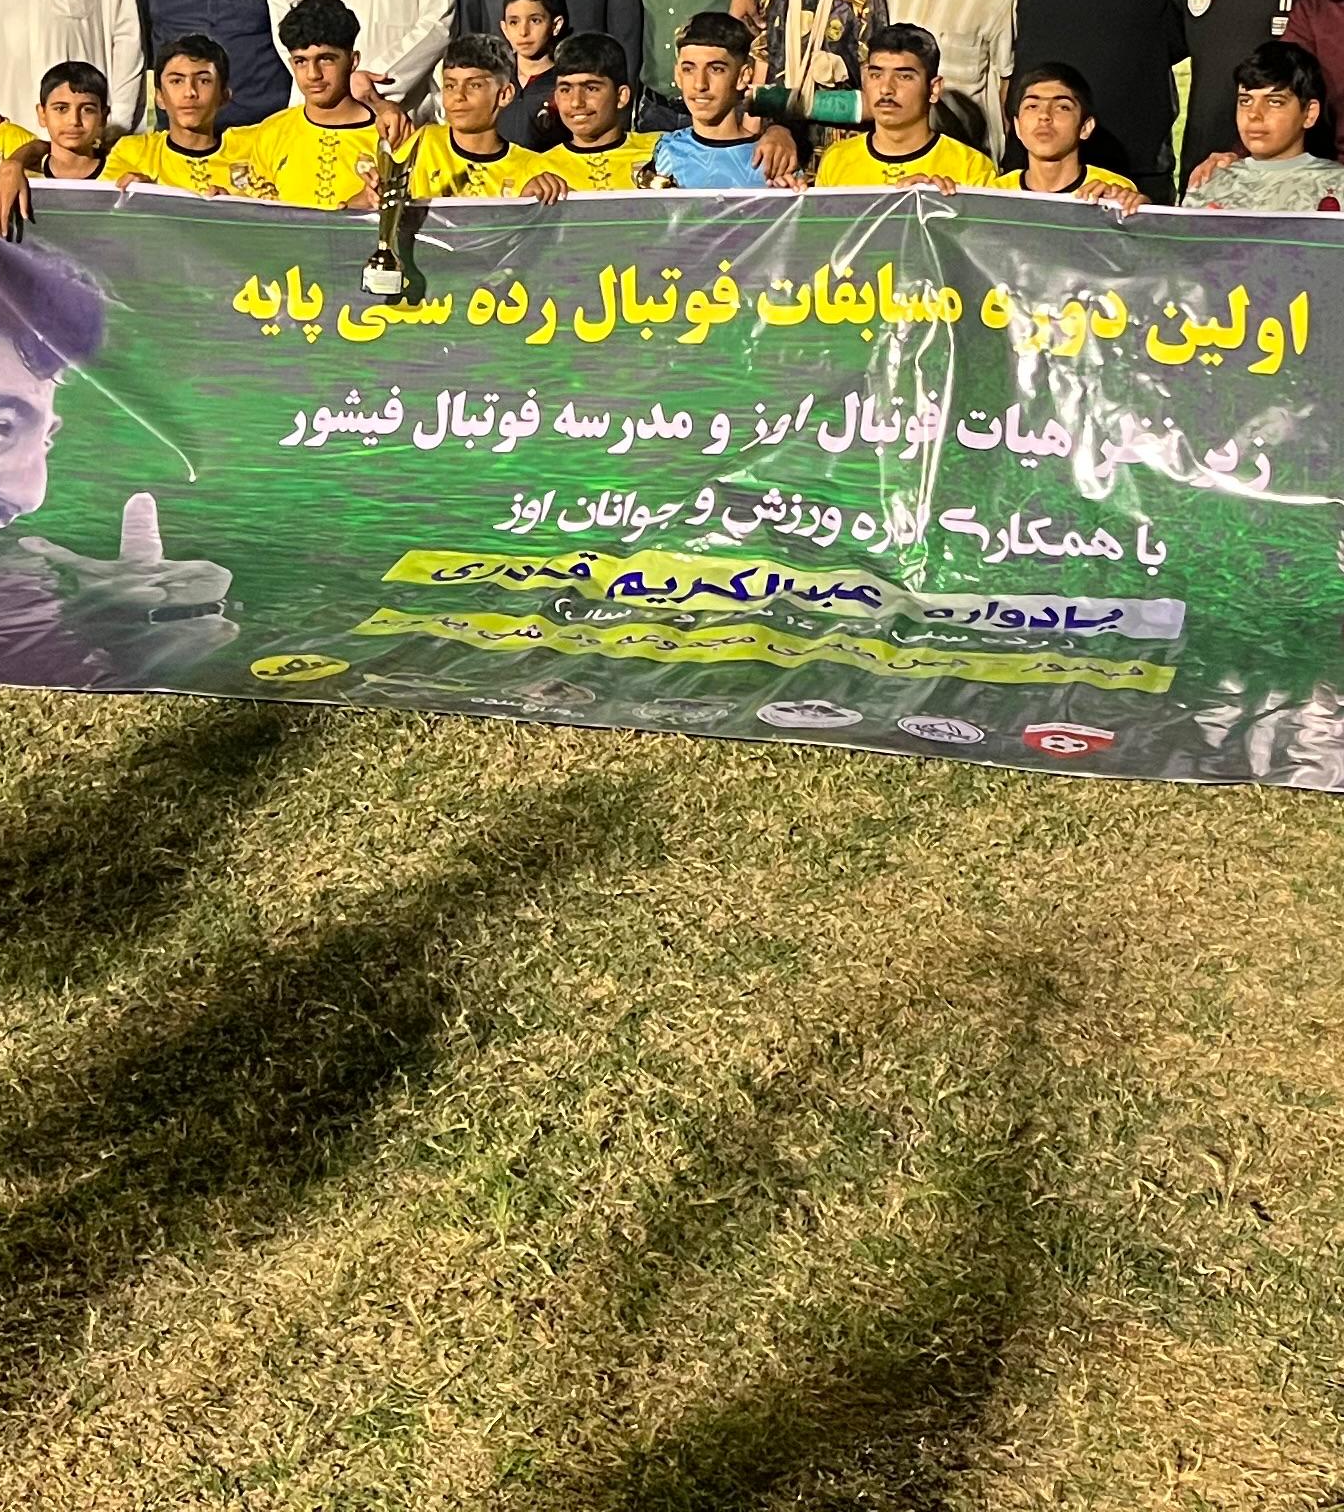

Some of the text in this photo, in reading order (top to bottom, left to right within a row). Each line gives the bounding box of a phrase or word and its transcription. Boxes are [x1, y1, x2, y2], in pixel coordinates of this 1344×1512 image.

[232, 259, 1310, 376] اولین دوره مسابقات فوتبال رده سنی پایه
[278, 384, 405, 447] فیشور
[412, 387, 542, 453] فوتبال
[553, 400, 694, 455] مدرسه
[700, 413, 732, 455] و
[816, 390, 943, 461] فوتبال
[957, 402, 1073, 468] هیات
[492, 488, 557, 535] اوز
[556, 490, 685, 544] جوانان
[684, 486, 716, 526] و
[721, 487, 843, 547] ورزش
[938, 504, 1125, 565] همکاری
[1136, 520, 1168, 576] با
[606, 565, 883, 610] عبدالکریم
[922, 599, 1125, 632] یادواره
